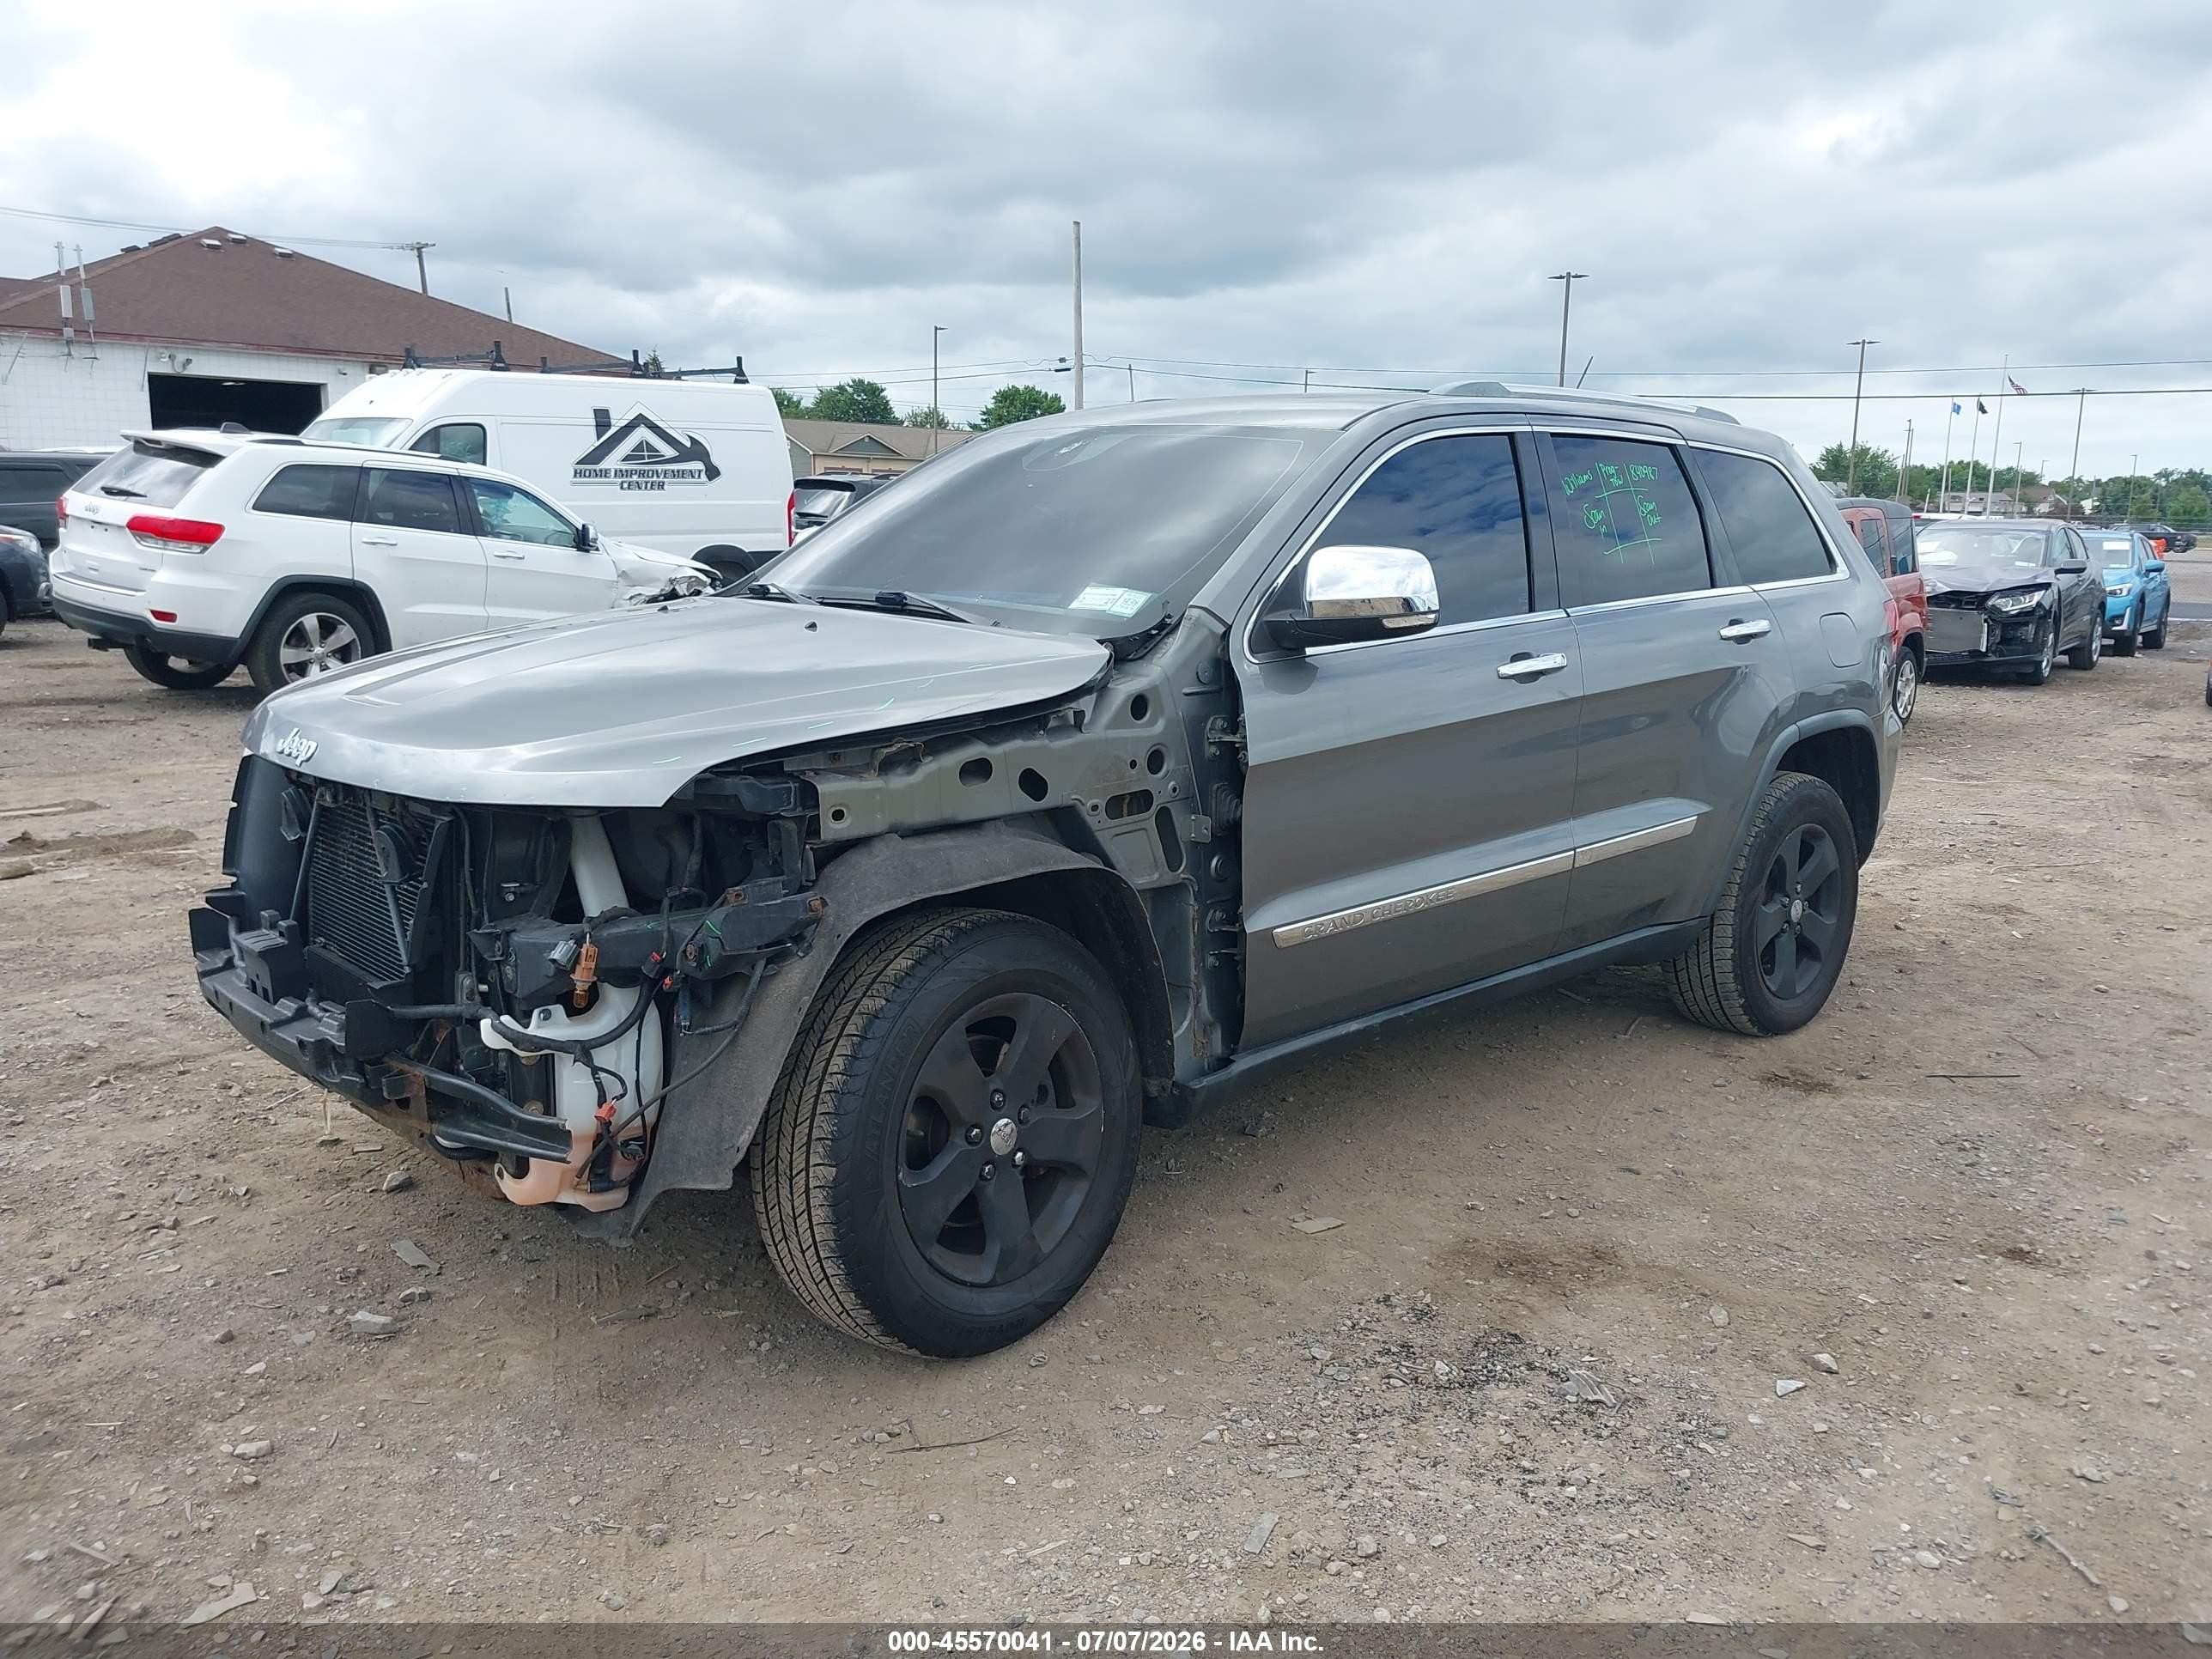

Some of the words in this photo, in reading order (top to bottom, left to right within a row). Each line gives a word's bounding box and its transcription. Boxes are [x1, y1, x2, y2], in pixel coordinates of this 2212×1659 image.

[574, 468, 611, 479] HOME
[613, 468, 703, 479] IMPROVEMENT
[619, 481, 666, 490] CENTER
[1562, 470, 1593, 495] Williams
[1583, 504, 1606, 529] Scan
[1637, 495, 1657, 516] Scan
[276, 728, 319, 767] Jeep
[1304, 915, 1365, 939] GRAND
[1372, 889, 1457, 921] CHEROKEE
